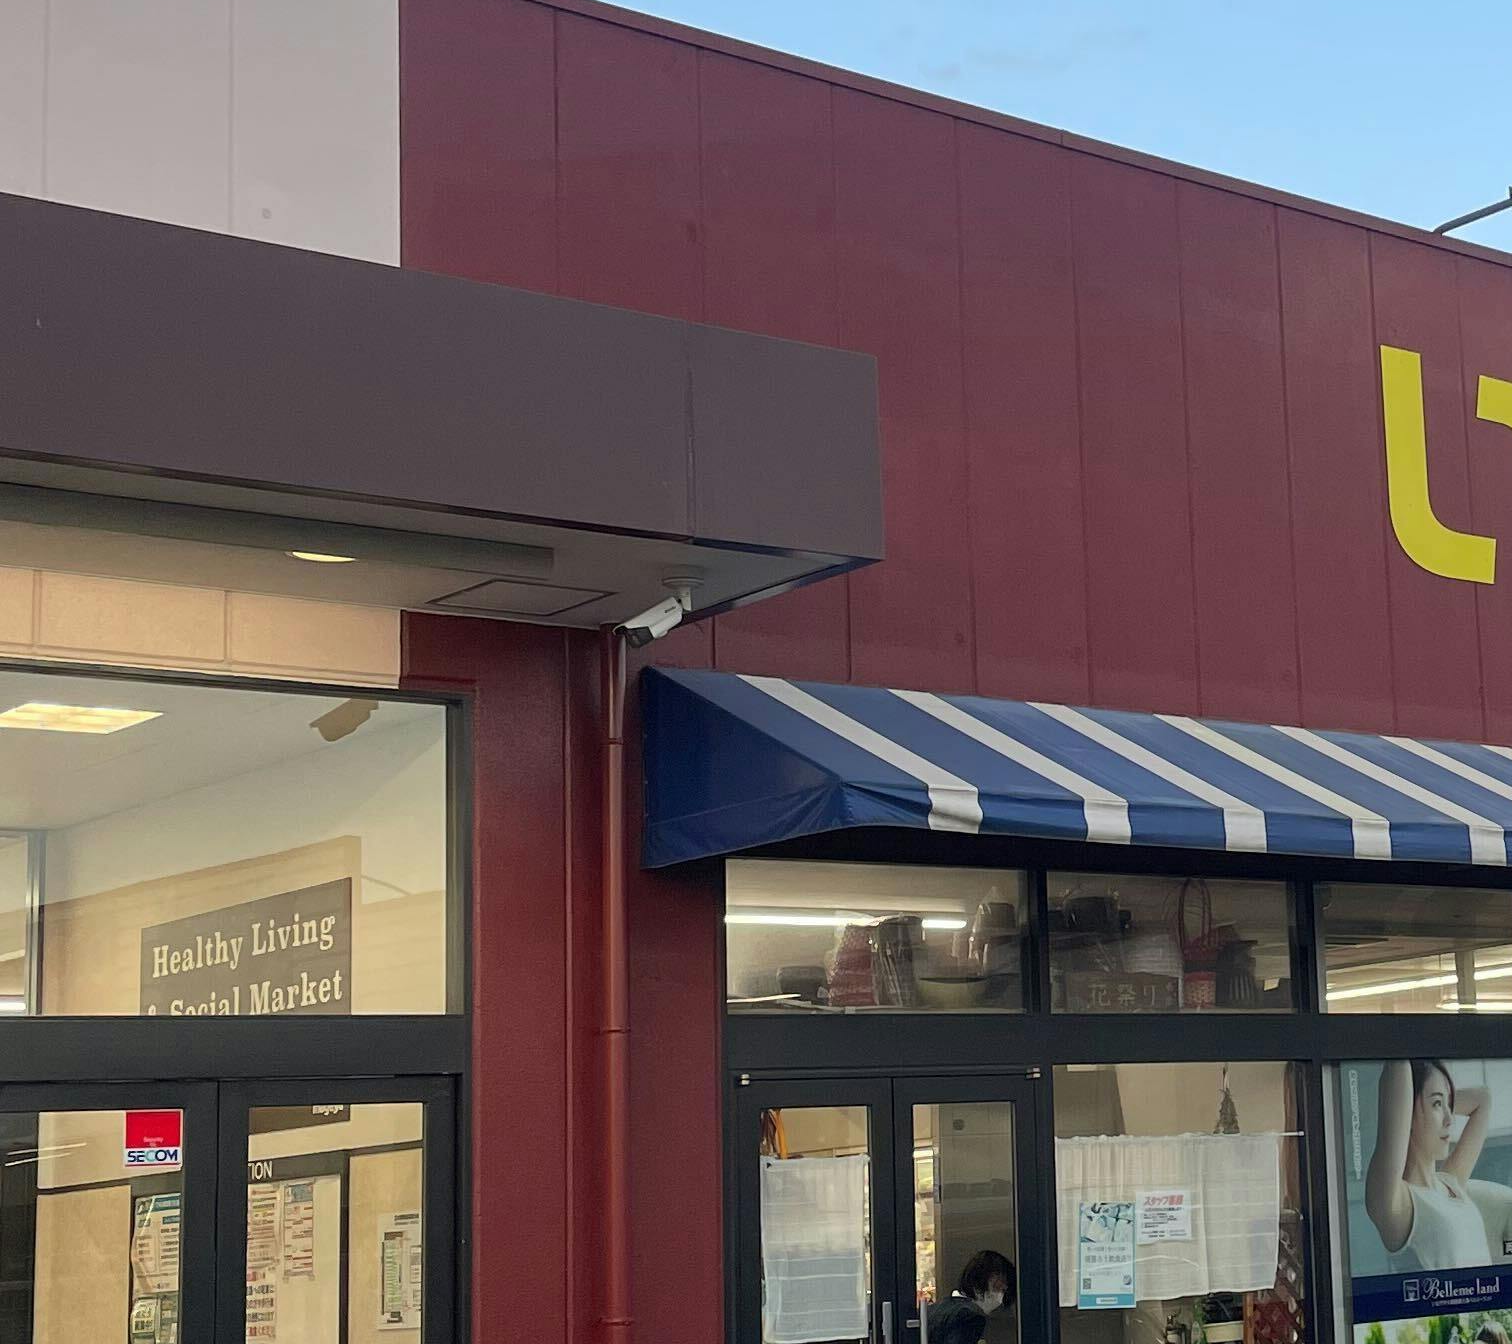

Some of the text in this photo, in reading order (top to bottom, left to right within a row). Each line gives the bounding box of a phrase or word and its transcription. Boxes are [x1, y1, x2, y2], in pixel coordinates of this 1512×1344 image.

[152, 912, 336, 979] Healthy Living
[249, 969, 343, 1016] Market
[127, 1149, 178, 1162] SECOM
[1476, 1276, 1500, 1295] land
